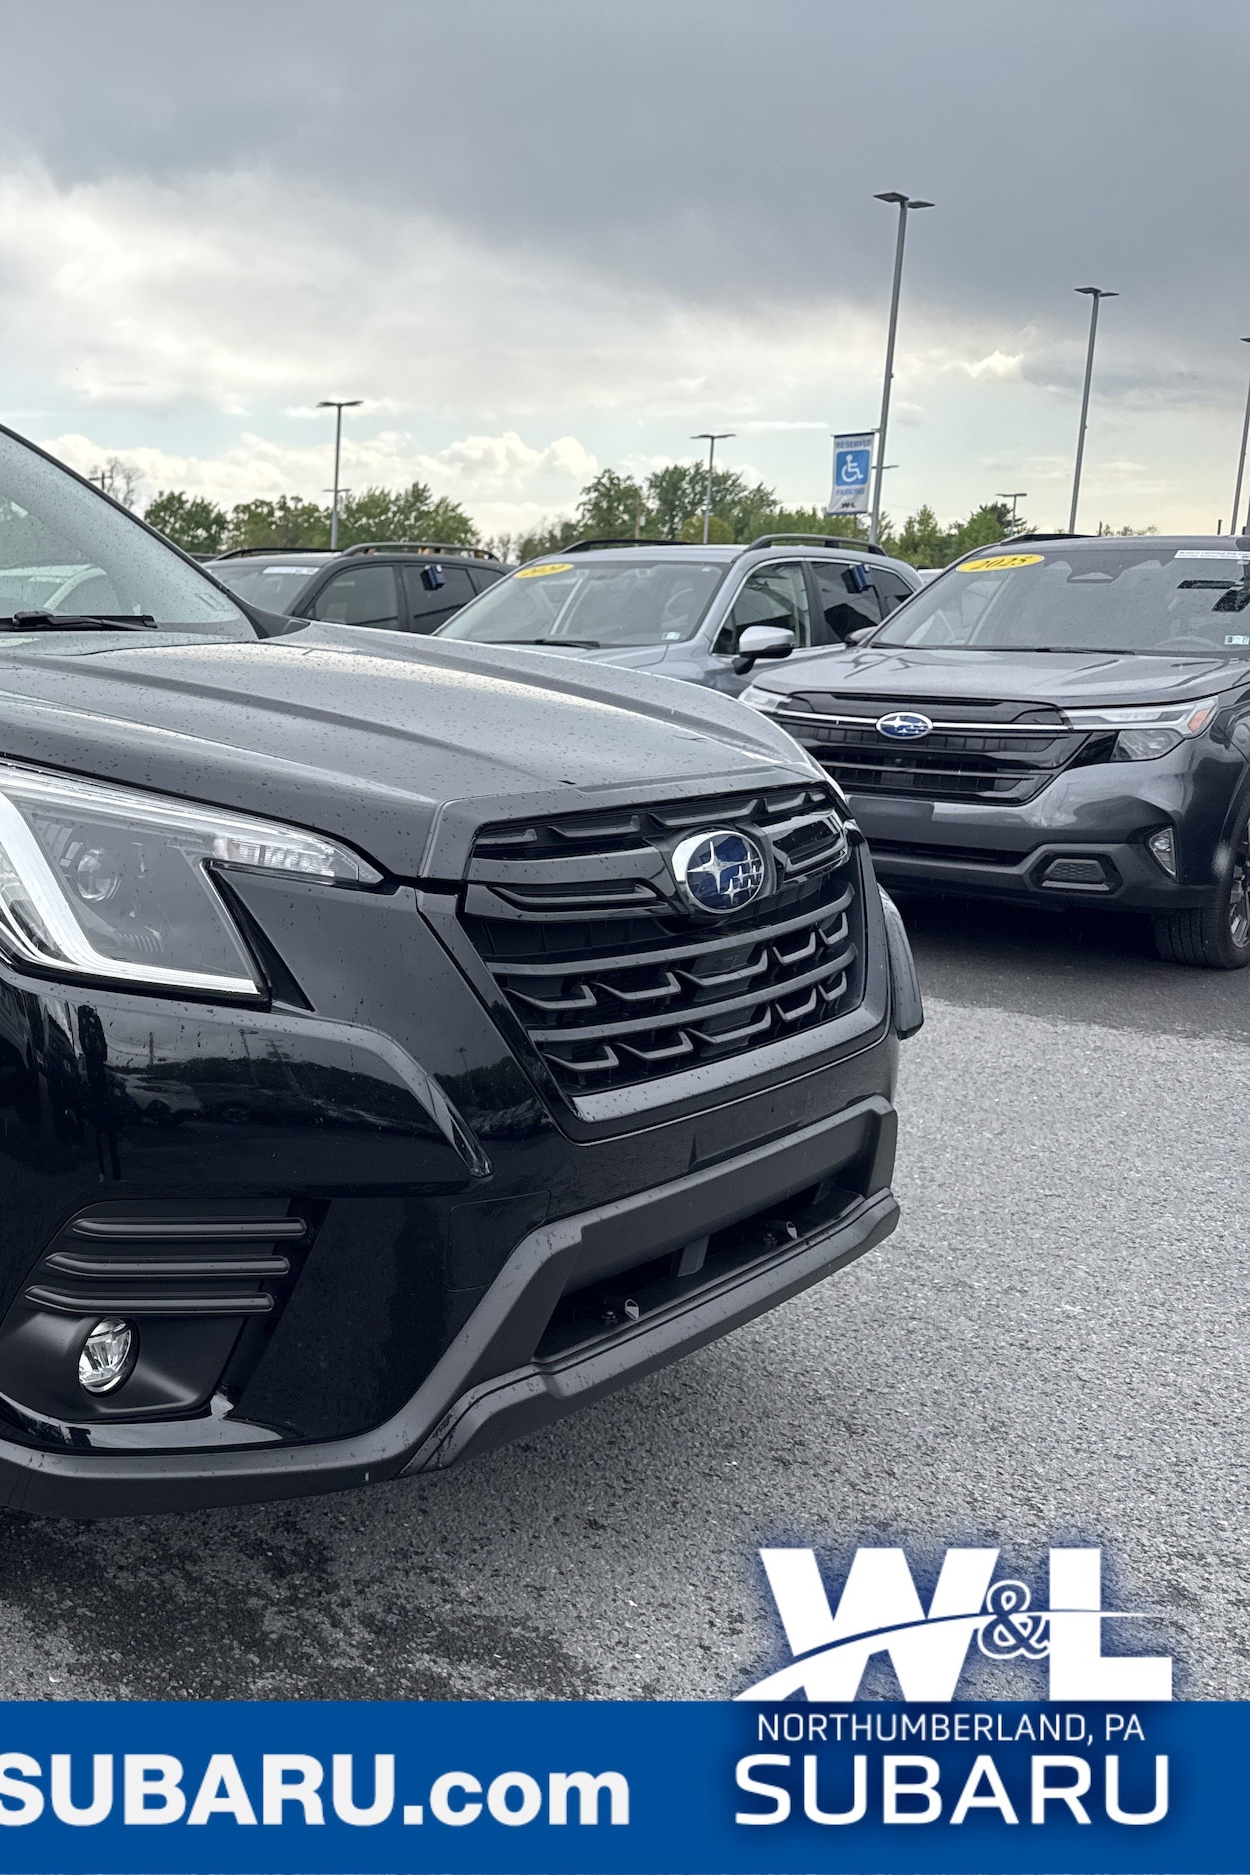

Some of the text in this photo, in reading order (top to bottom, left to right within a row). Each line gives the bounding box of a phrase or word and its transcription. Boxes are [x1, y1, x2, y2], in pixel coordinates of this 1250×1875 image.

[835, 439, 872, 449] RESERVED
[836, 488, 865, 496] PARKING
[970, 556, 1034, 571] 2025
